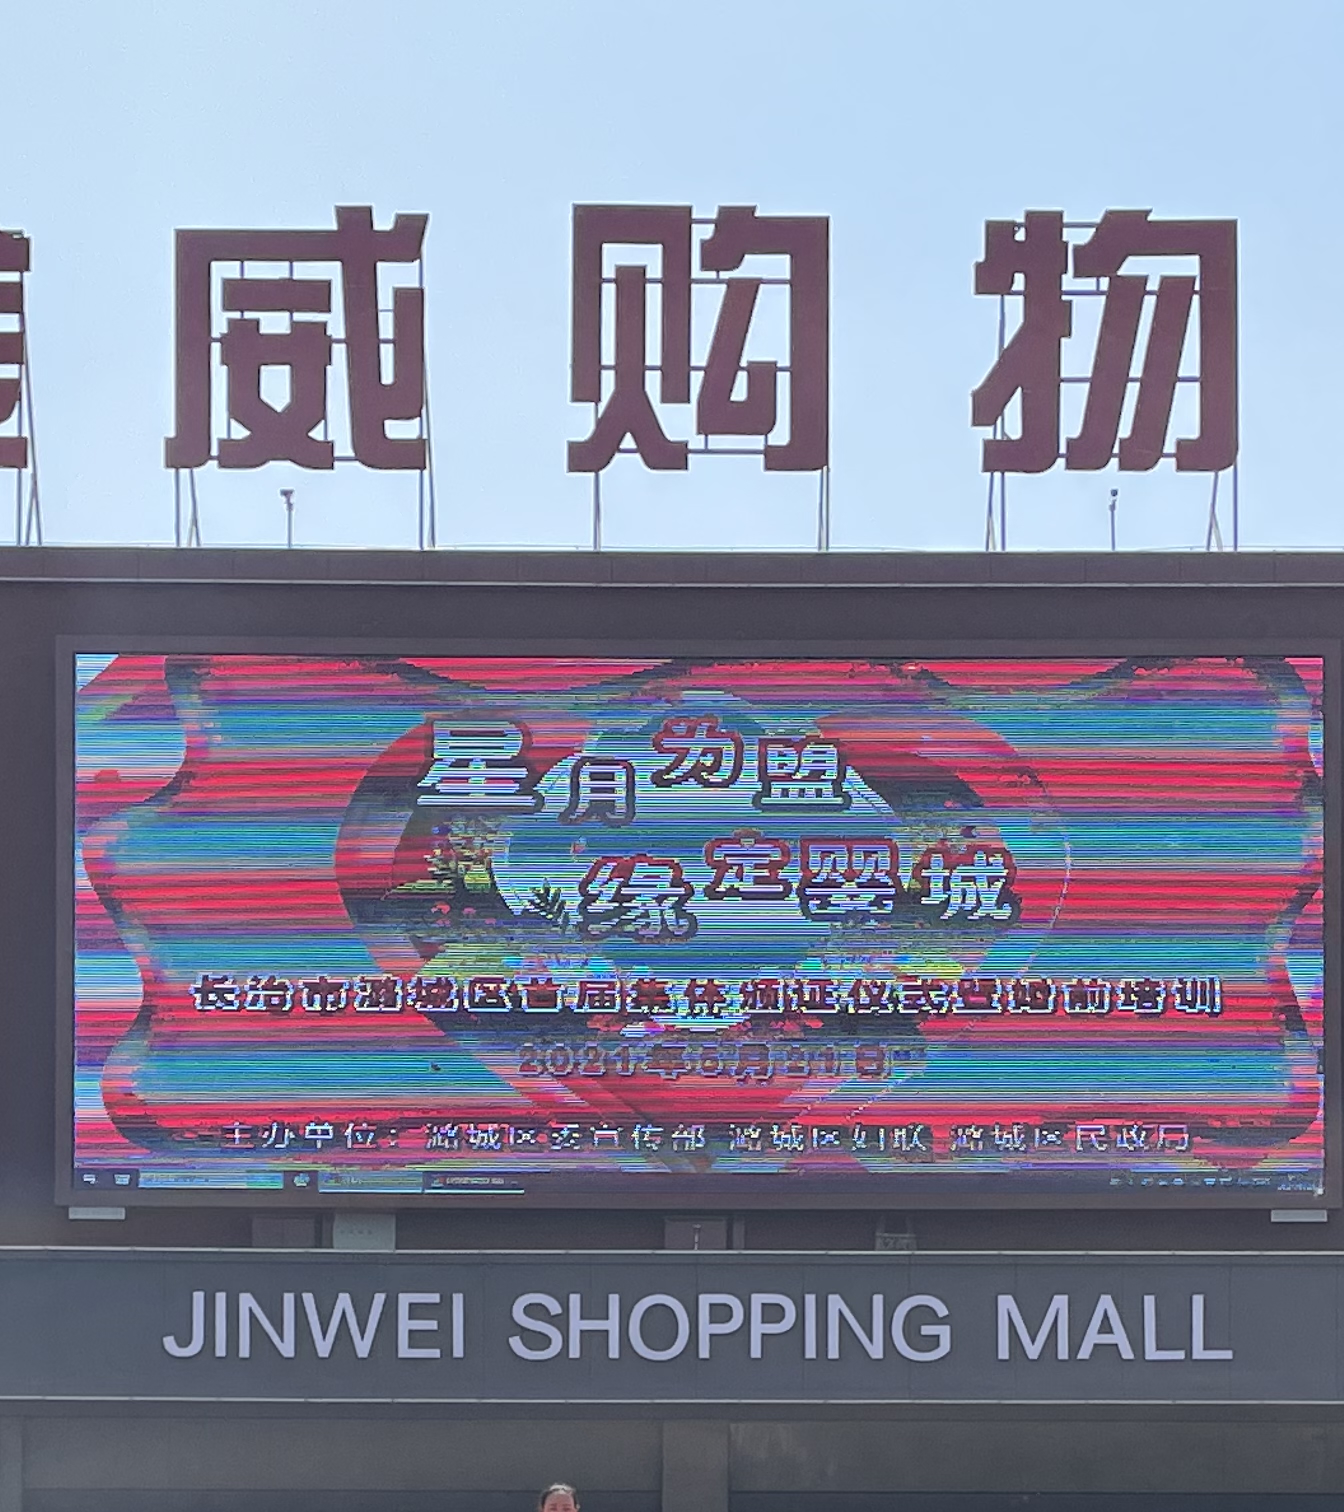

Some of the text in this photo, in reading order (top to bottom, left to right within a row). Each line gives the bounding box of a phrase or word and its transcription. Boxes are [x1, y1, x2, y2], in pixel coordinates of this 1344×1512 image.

[416, 715, 851, 827] 星月为盟
[162, 1290, 1234, 1362] JINWEI SHOPPING MALL
